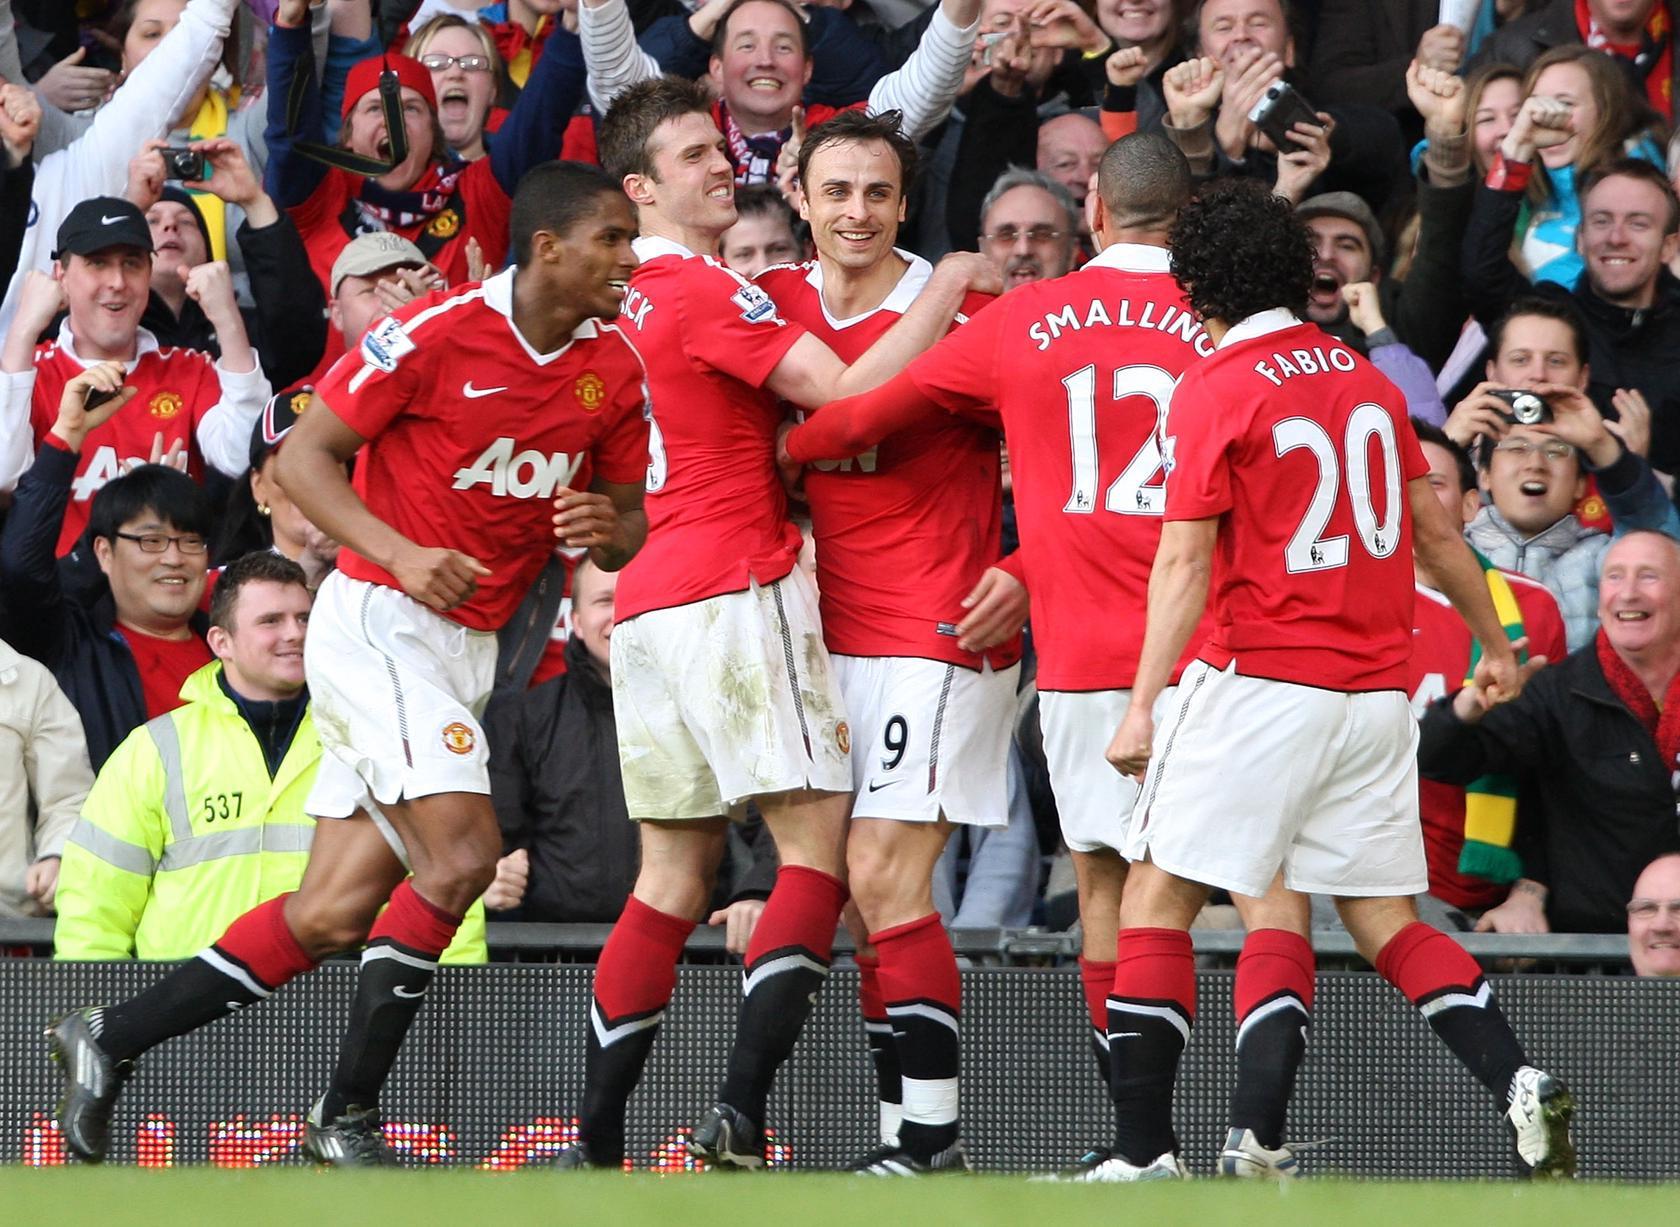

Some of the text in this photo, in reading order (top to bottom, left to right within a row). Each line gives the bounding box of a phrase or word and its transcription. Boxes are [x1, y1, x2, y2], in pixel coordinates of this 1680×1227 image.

[1254, 346, 1357, 387] FABIO
[451, 436, 585, 499] AON
[1061, 363, 1178, 515] 12
[1272, 402, 1403, 575] 20
[882, 713, 909, 772] 9
[204, 791, 243, 823] 537
